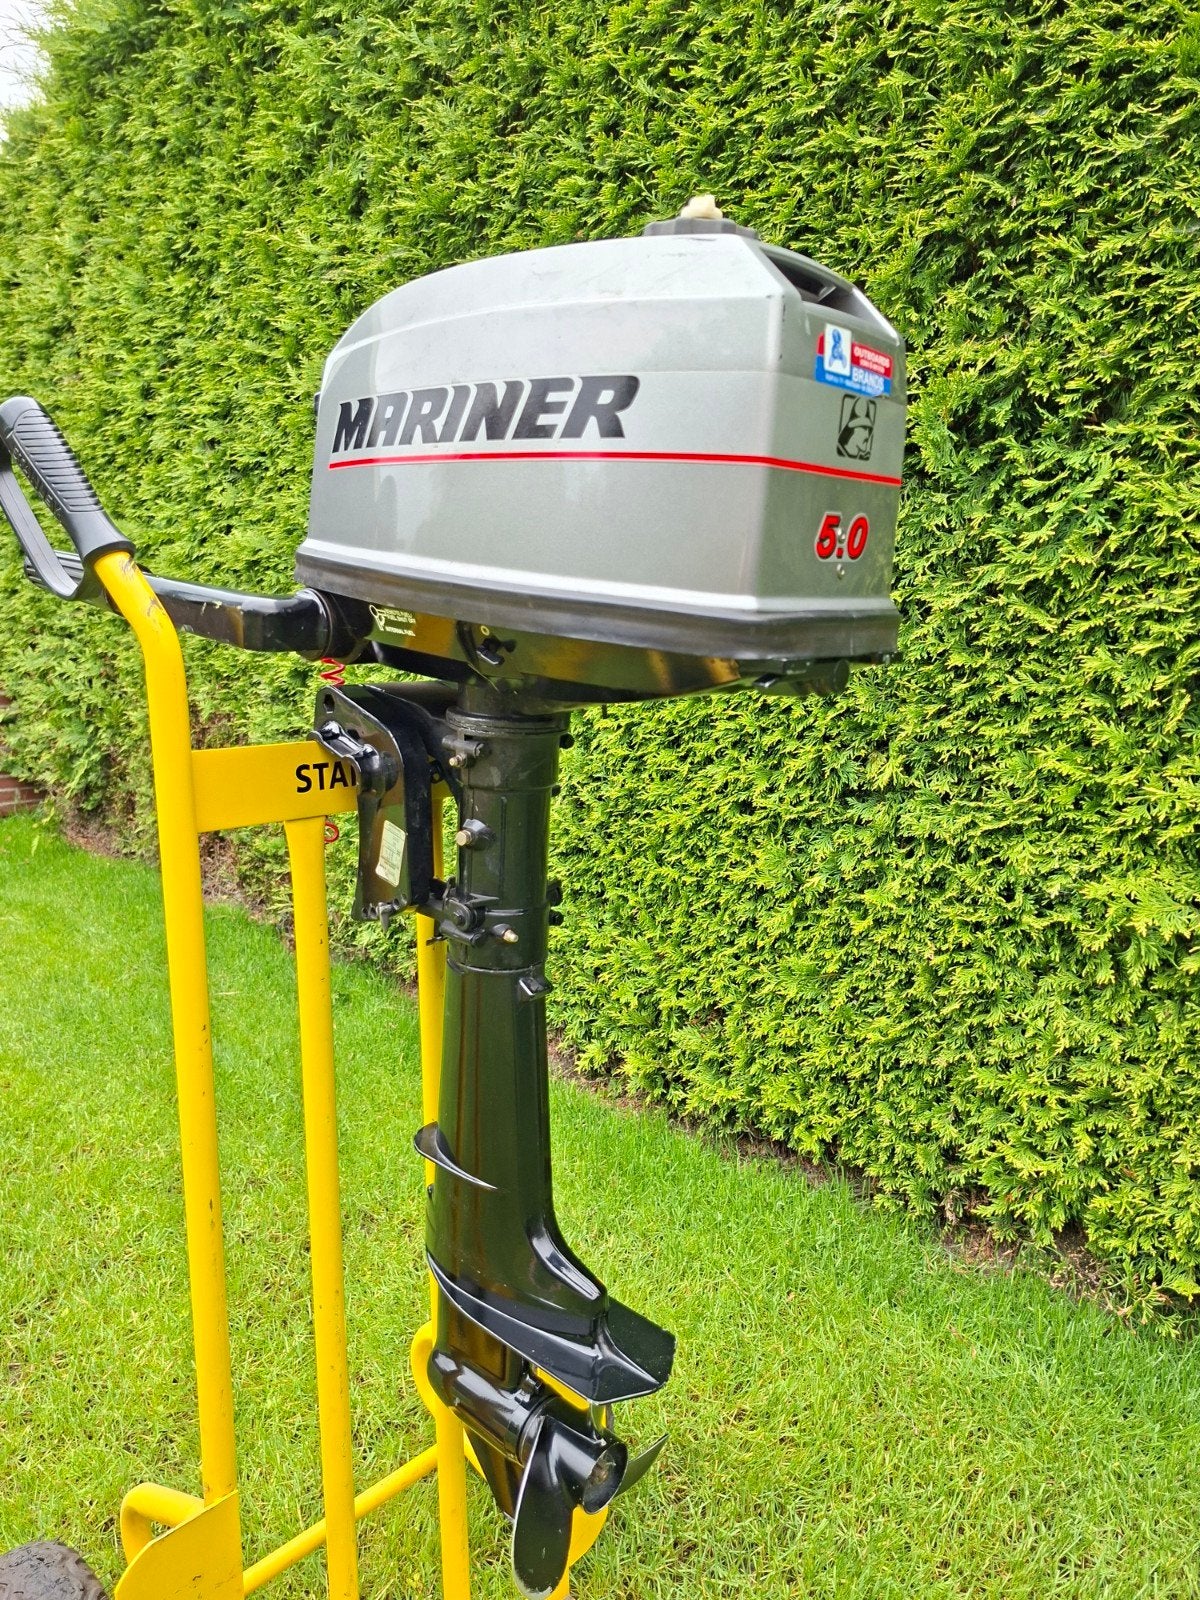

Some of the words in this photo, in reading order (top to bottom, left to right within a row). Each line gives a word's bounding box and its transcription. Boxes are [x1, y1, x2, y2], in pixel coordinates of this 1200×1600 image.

[852, 366, 885, 392] BRANDS
[331, 375, 640, 454] MARINER
[815, 512, 869, 560] 5.0
